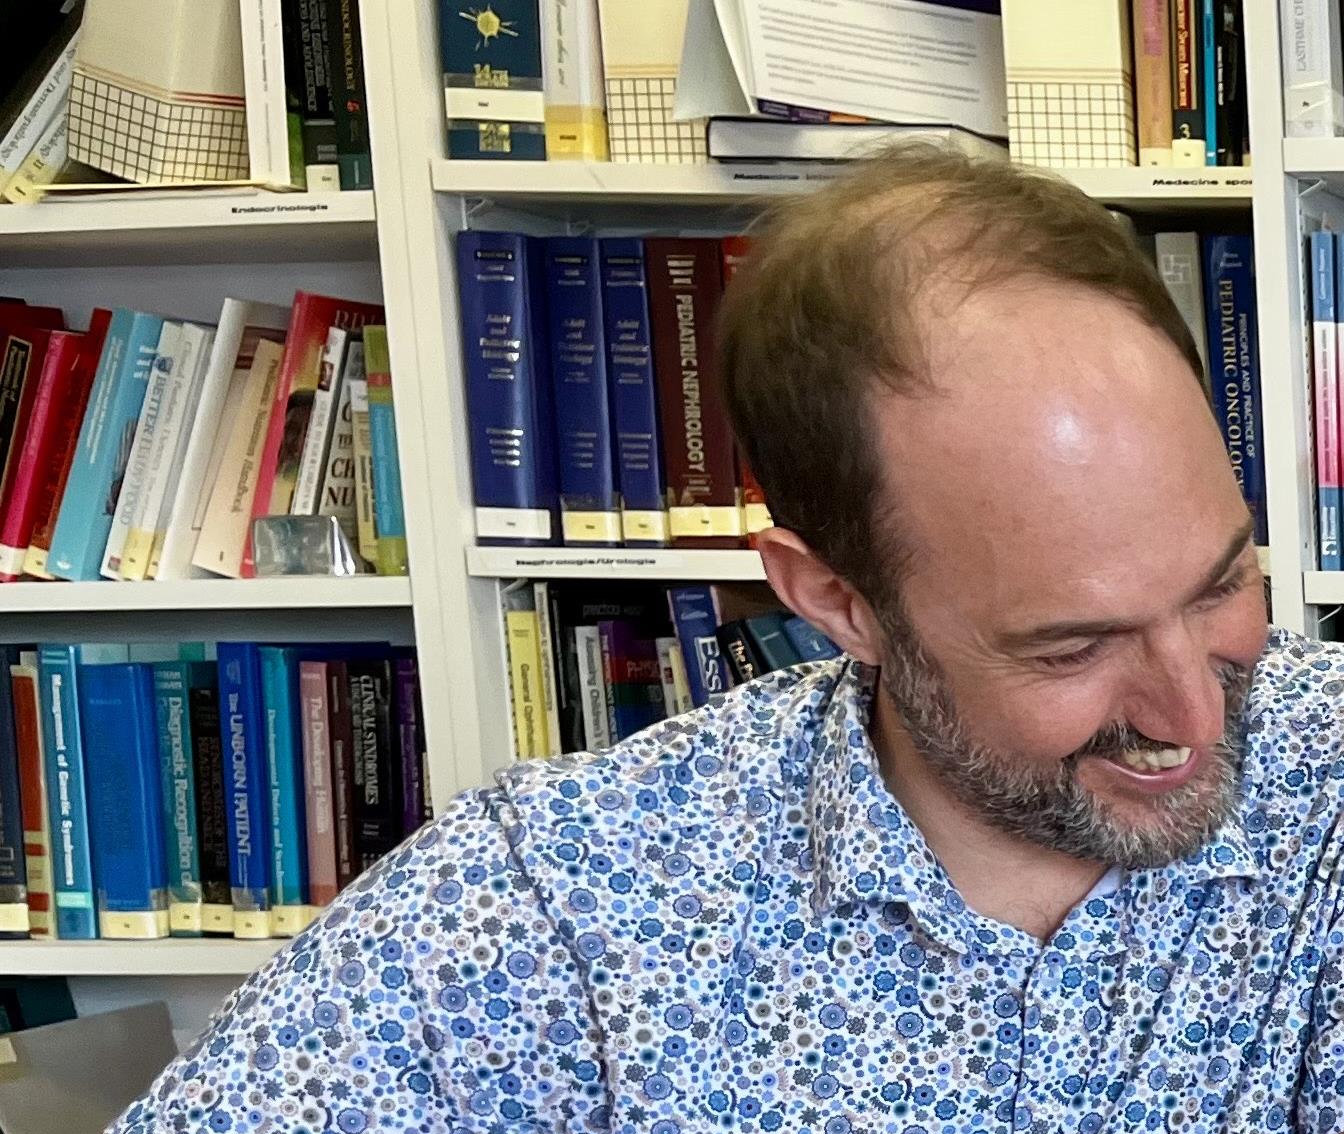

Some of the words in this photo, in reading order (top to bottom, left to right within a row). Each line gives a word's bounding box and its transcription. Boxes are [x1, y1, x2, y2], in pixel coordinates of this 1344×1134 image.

[675, 294, 698, 367] PEDIATRIC
[1219, 280, 1238, 378] PEDIATRIC
[1239, 313, 1249, 367] PRINCIPLES
[142, 375, 167, 434] BETTER
[1242, 370, 1251, 392] AND
[682, 370, 705, 472] NEPHROLOGY
[1243, 395, 1254, 441] PRACTICE
[1245, 444, 1255, 459] OF
[520, 663, 534, 703] General
[585, 636, 600, 685] Assessing
[310, 695, 323, 719] The
[359, 675, 375, 732] CLINICAL
[57, 754, 68, 767] of
[169, 696, 187, 776] Diagnostic
[229, 714, 247, 788] UNBORN
[311, 722, 326, 787] Developing
[361, 732, 379, 805] SYNDROMES
[174, 778, 193, 869] Recognition
[233, 792, 250, 856] PATIENT
